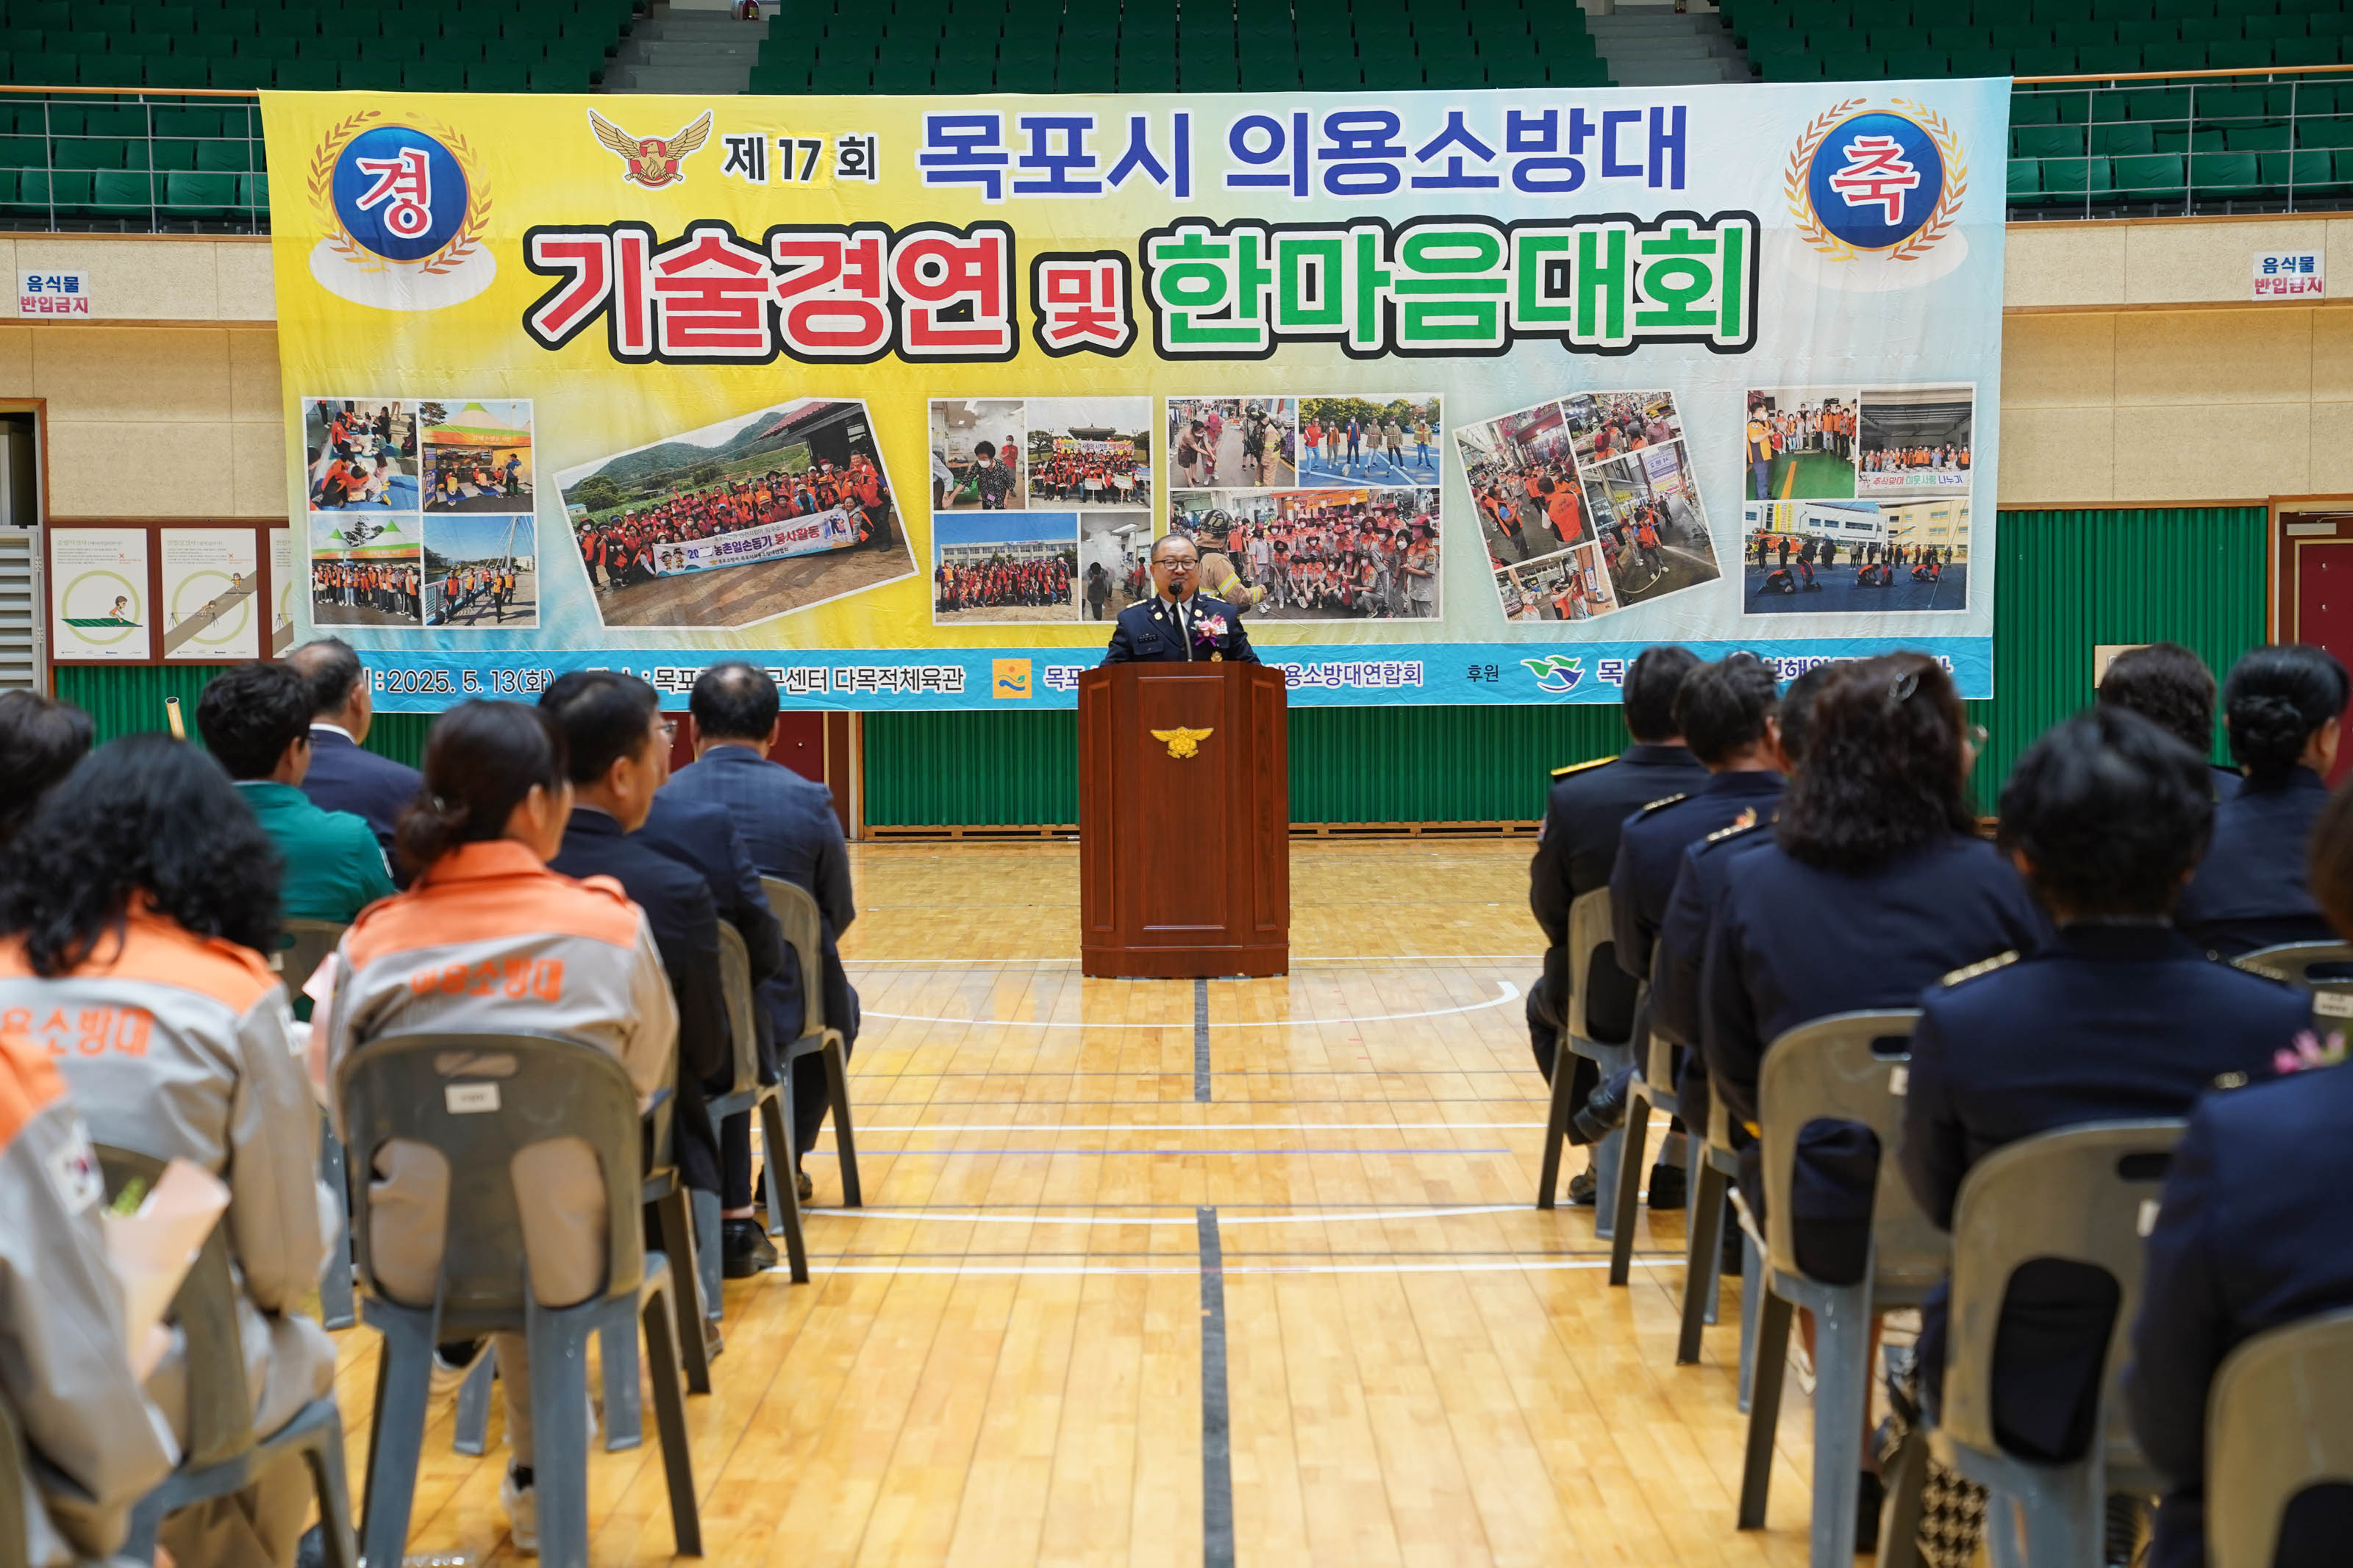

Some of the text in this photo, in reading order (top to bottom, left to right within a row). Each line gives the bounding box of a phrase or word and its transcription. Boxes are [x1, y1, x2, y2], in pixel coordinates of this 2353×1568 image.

[724, 104, 1688, 199] 제 17 회 목포시 의용소방대
[356, 148, 430, 237] 경
[1832, 137, 1918, 225] 축
[2262, 256, 2315, 274] 음식물
[26, 275, 79, 293] 음식물
[528, 220, 1749, 357] 기술경연 및 한마음대회
[2254, 276, 2323, 295] 반입금지
[20, 296, 88, 314] 반입금지
[1873, 475, 1963, 485] 추석맞이 이웃사랑 나누기
[713, 534, 773, 558] 농촌일손돕기
[774, 524, 821, 546] 봉사활동
[835, 667, 964, 692] 다목적체육관
[1046, 663, 1421, 688] 목포 용소방대연합회
[1466, 665, 1499, 682] 후원
